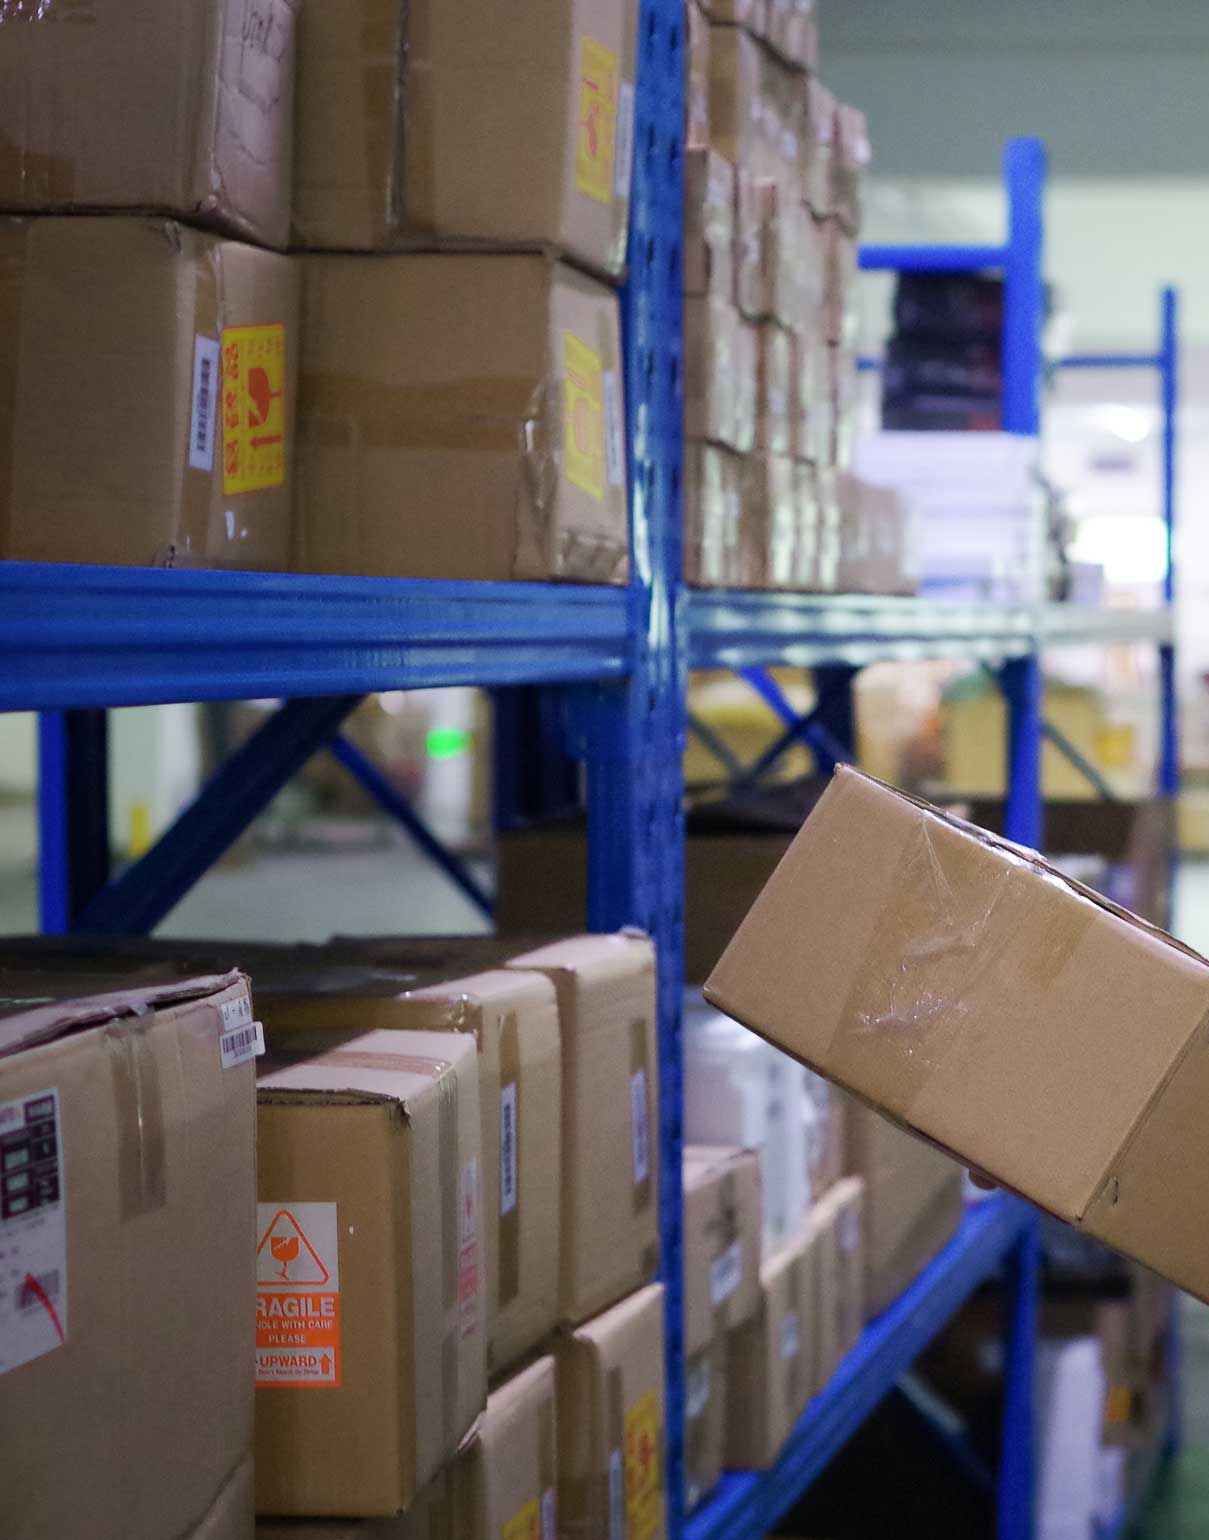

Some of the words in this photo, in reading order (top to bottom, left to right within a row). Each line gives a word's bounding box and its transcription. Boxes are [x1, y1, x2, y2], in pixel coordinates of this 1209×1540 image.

[281, 1320, 305, 1329] WITH
[308, 1320, 333, 1329] CARE
[268, 1334, 307, 1344] PLEASE
[260, 1355, 317, 1367] UPWARD
